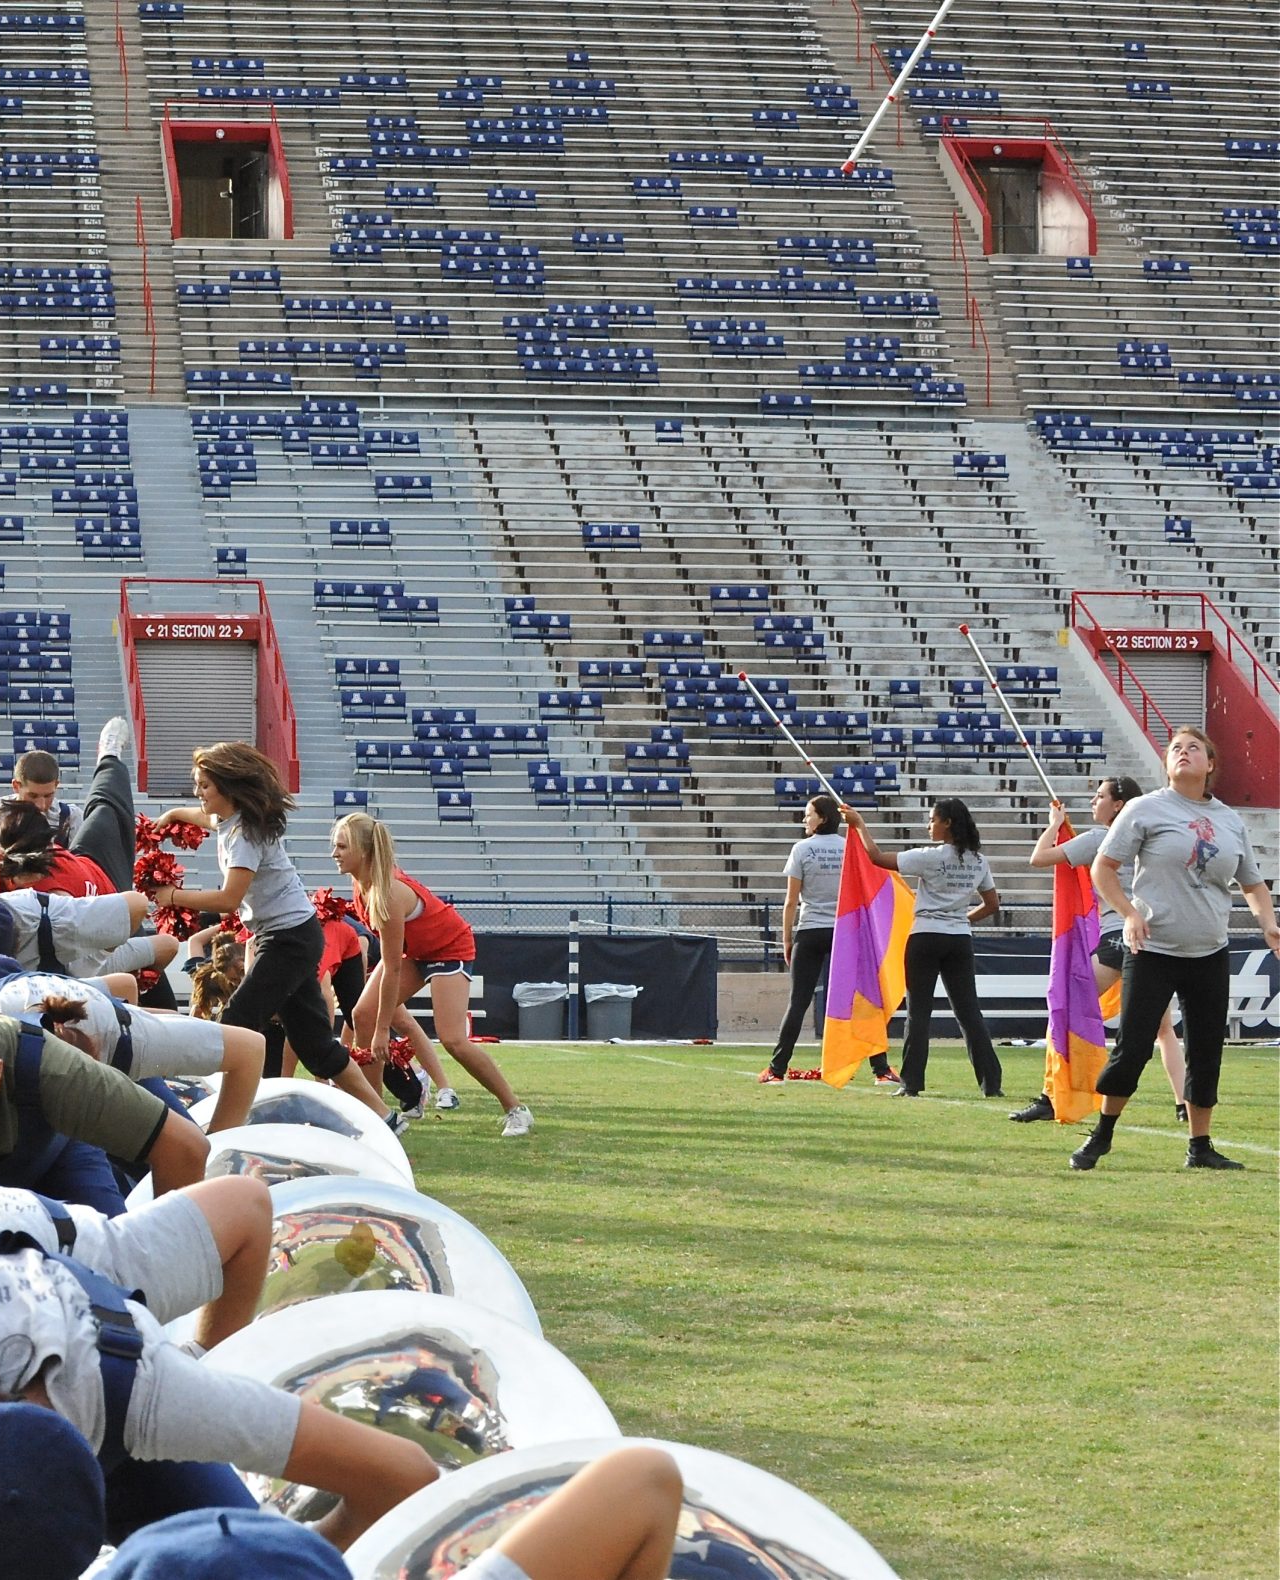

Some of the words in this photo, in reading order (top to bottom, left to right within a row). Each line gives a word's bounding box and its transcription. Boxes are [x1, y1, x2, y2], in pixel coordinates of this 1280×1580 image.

[157, 624, 169, 638] 21
[171, 624, 216, 638] SECTION
[218, 624, 232, 638] 22
[1116, 635, 1128, 649] 22
[1131, 635, 1173, 649] SECTION
[1175, 636, 1188, 649] 23
